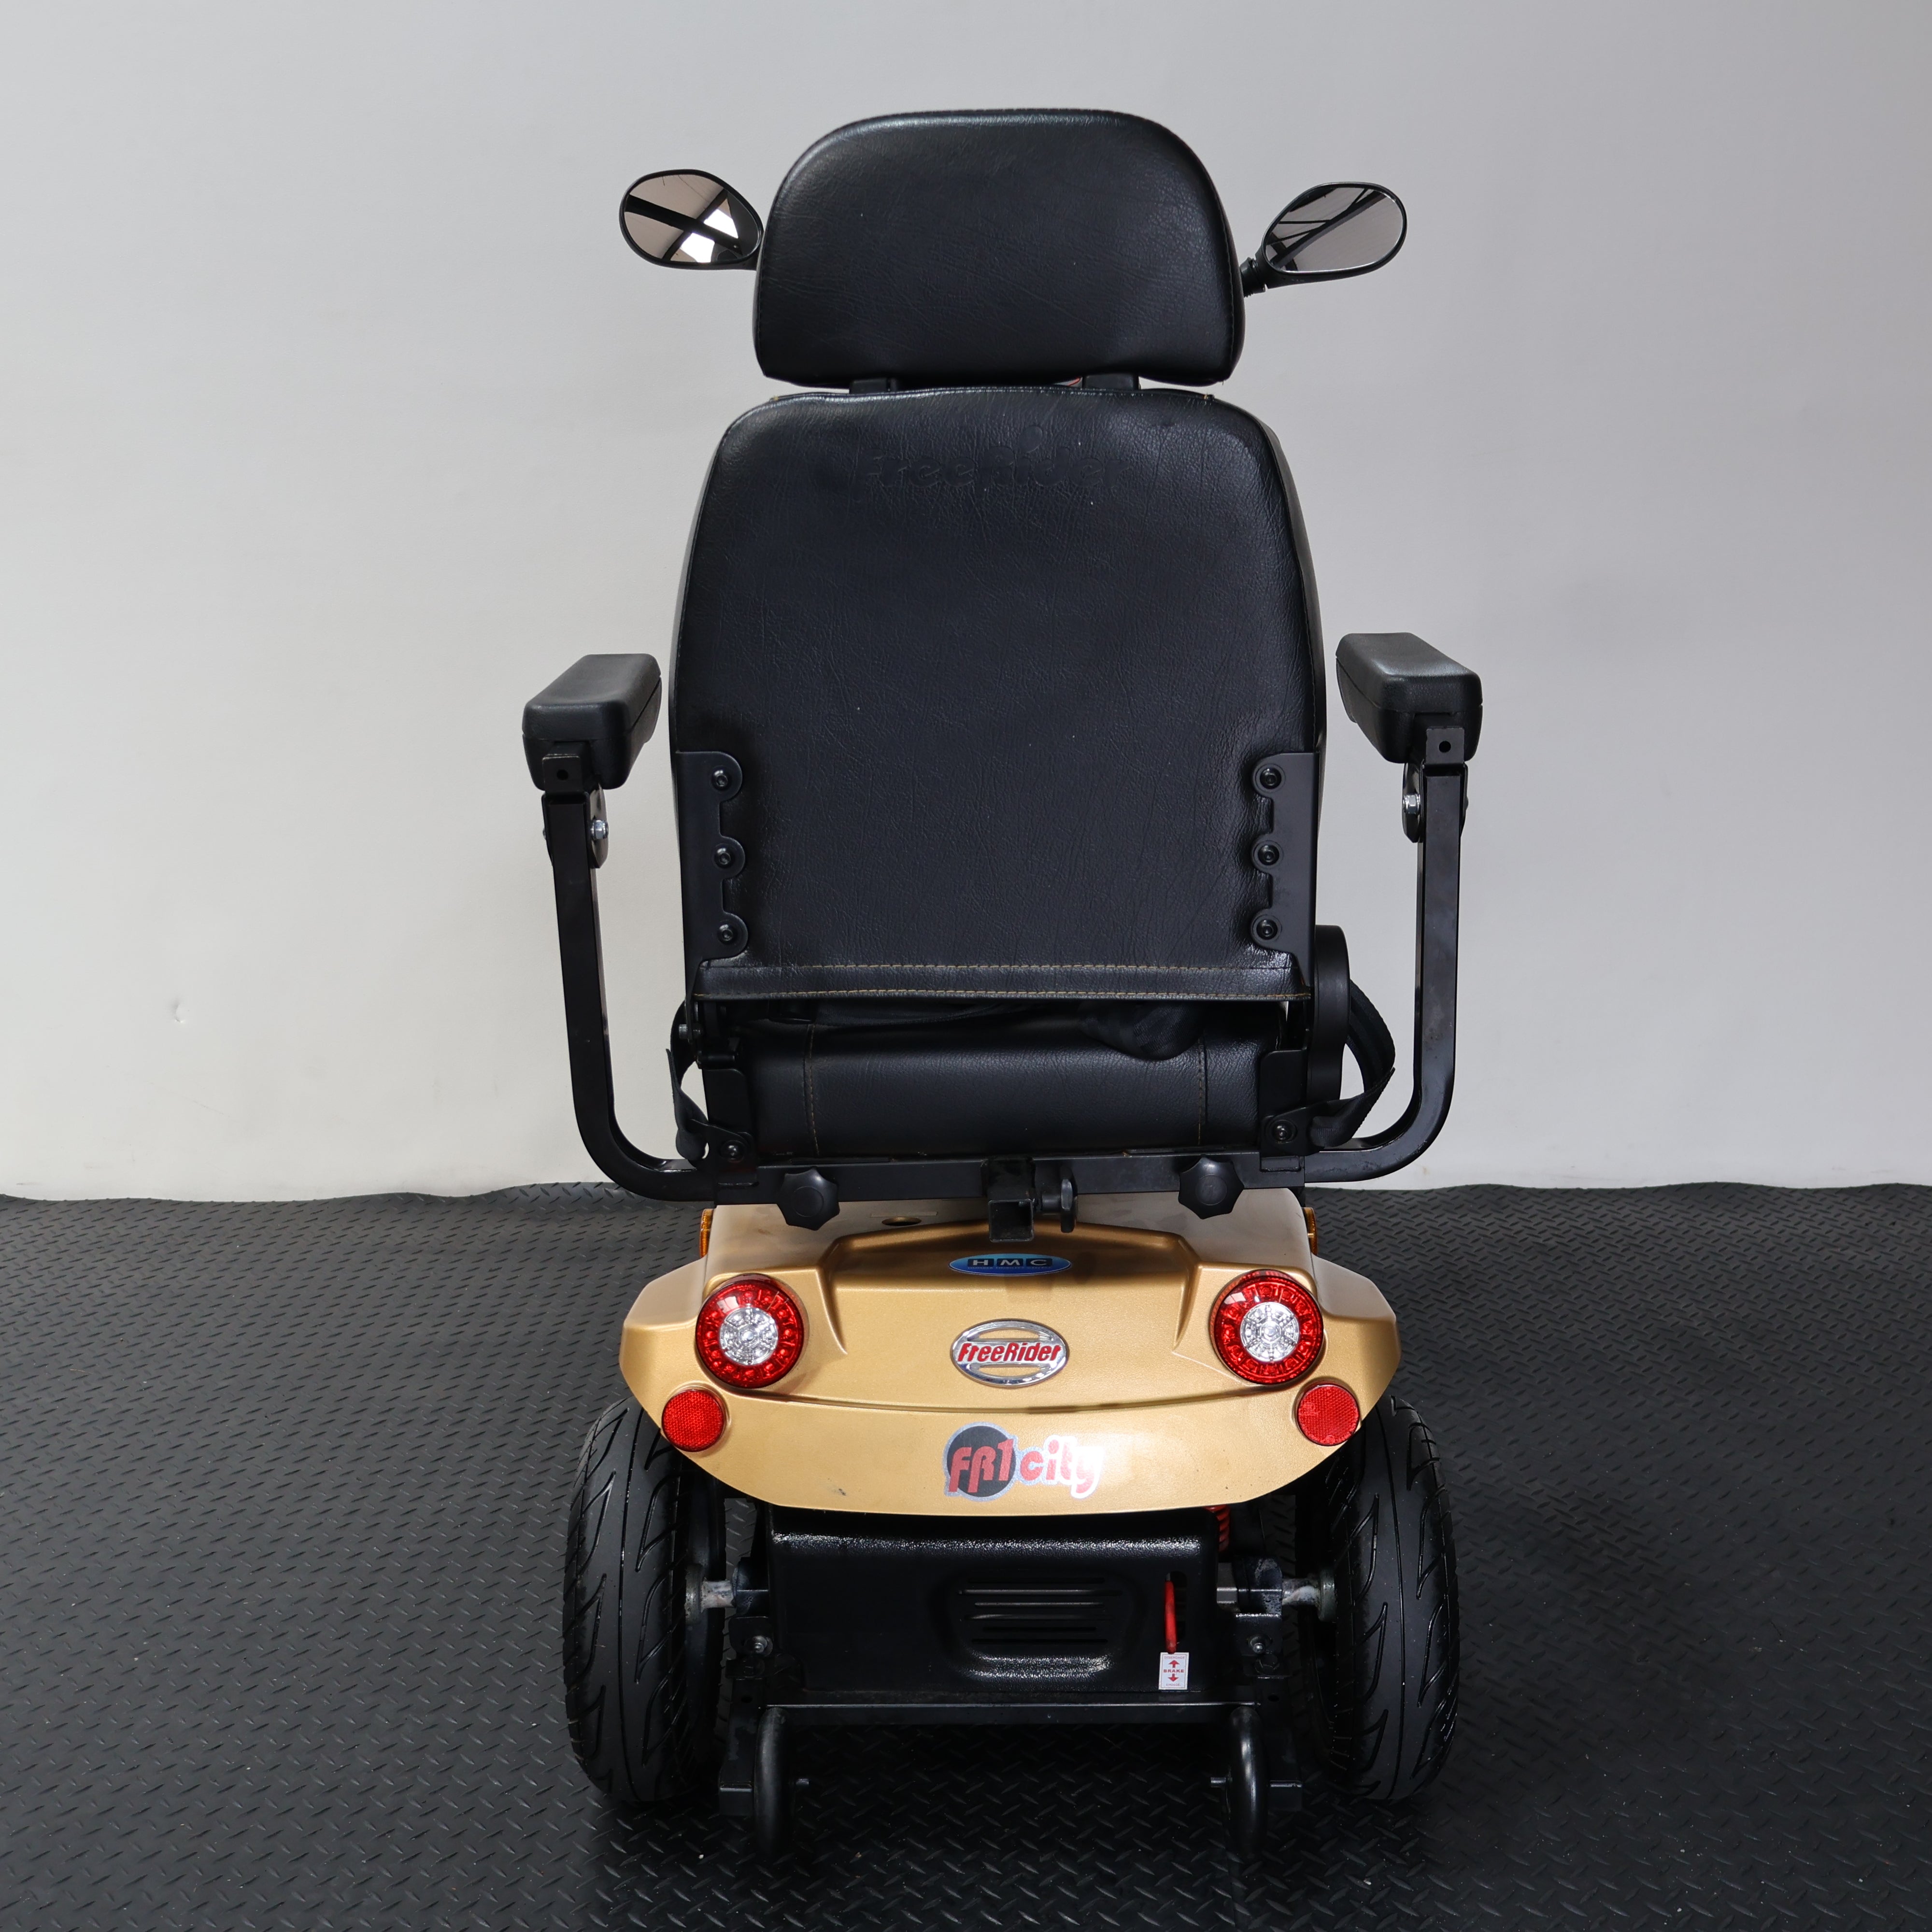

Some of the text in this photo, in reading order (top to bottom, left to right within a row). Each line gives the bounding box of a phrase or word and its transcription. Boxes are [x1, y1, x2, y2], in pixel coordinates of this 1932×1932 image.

[957, 1342, 1061, 1362] FreeRider
[948, 1439, 1096, 1493] FR1 city
